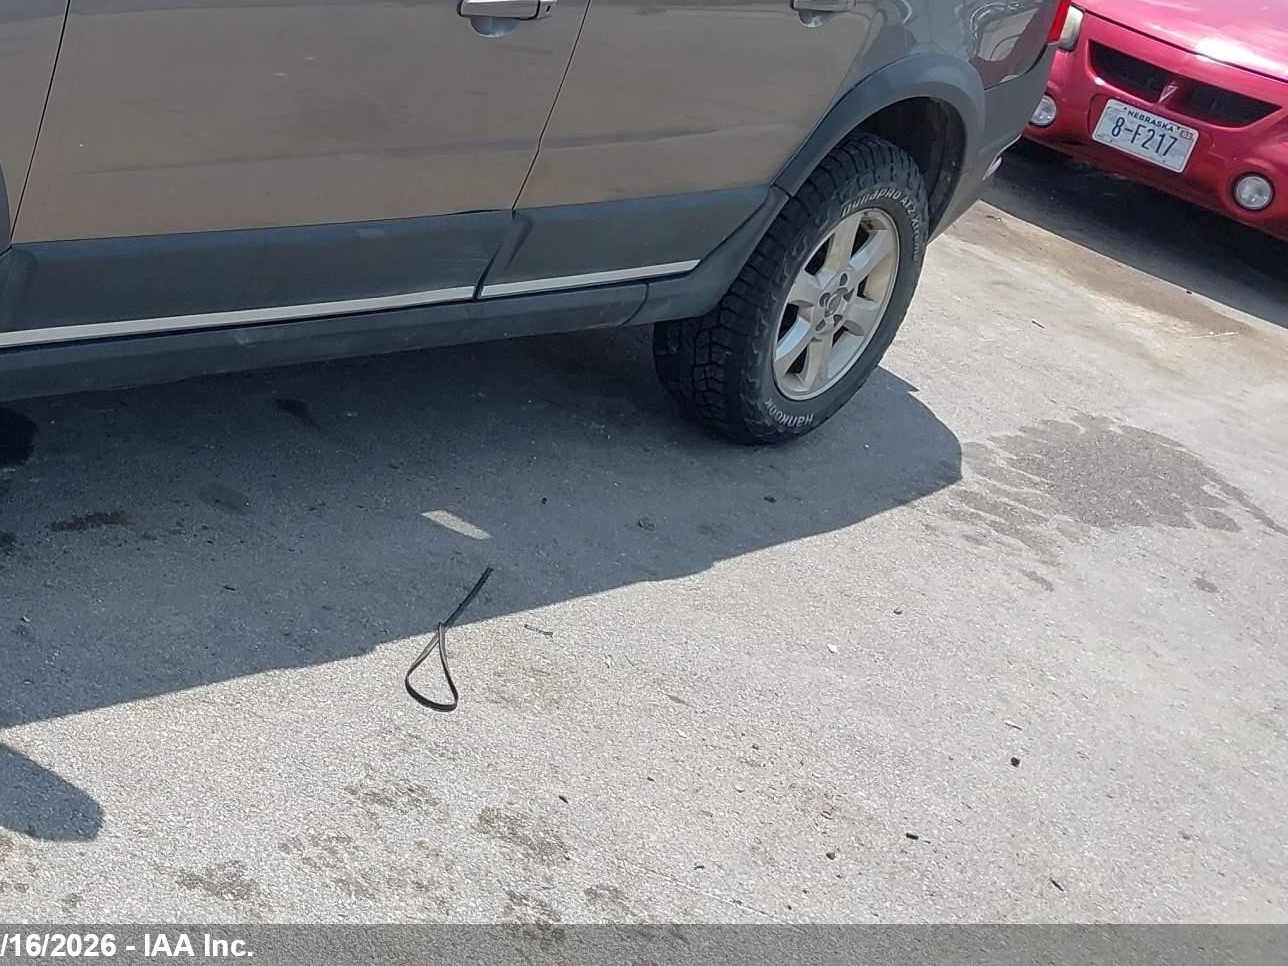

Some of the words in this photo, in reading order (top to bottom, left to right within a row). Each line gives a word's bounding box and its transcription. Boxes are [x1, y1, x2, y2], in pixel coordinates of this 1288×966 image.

[1127, 110, 1174, 132] NEBRASKA
[1111, 117, 1178, 156] 8-F217
[900, 196, 916, 215] AT2
